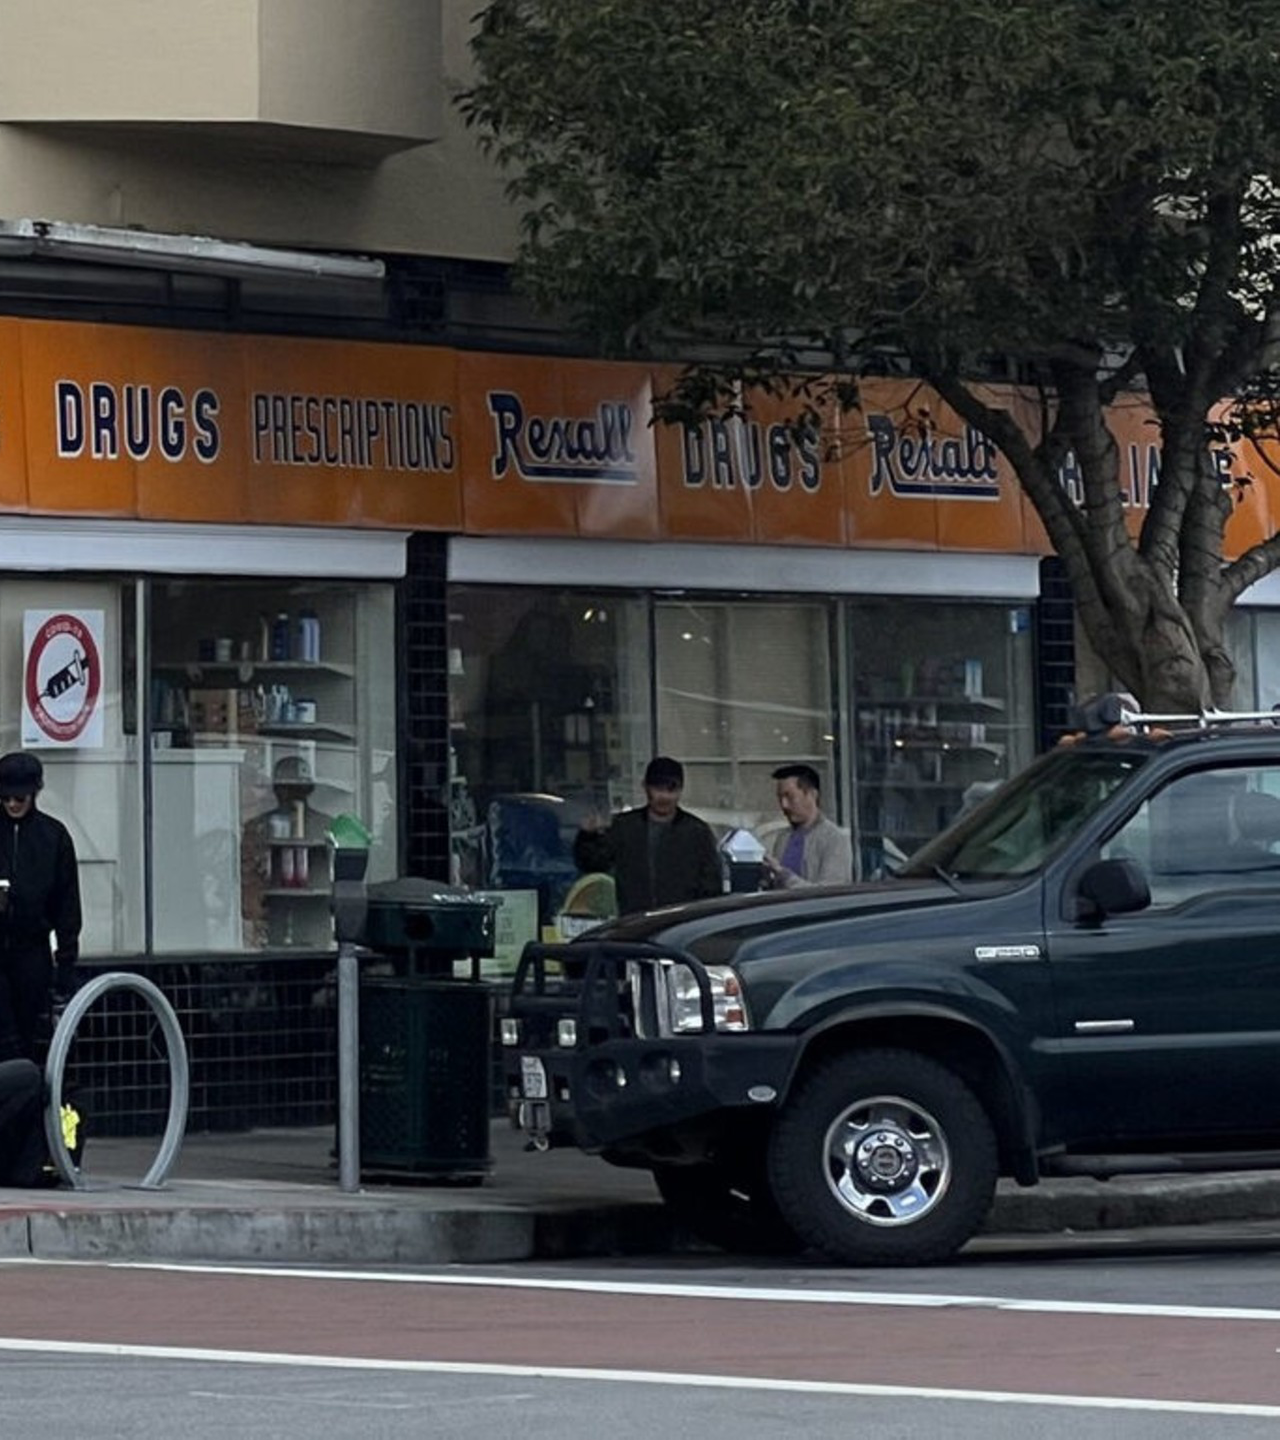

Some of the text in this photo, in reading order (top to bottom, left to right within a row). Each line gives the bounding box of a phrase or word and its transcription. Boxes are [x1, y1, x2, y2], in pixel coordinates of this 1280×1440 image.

[55, 380, 455, 474] DRUGS PRESCRIPTIONS
[487, 389, 638, 486] Rexall
